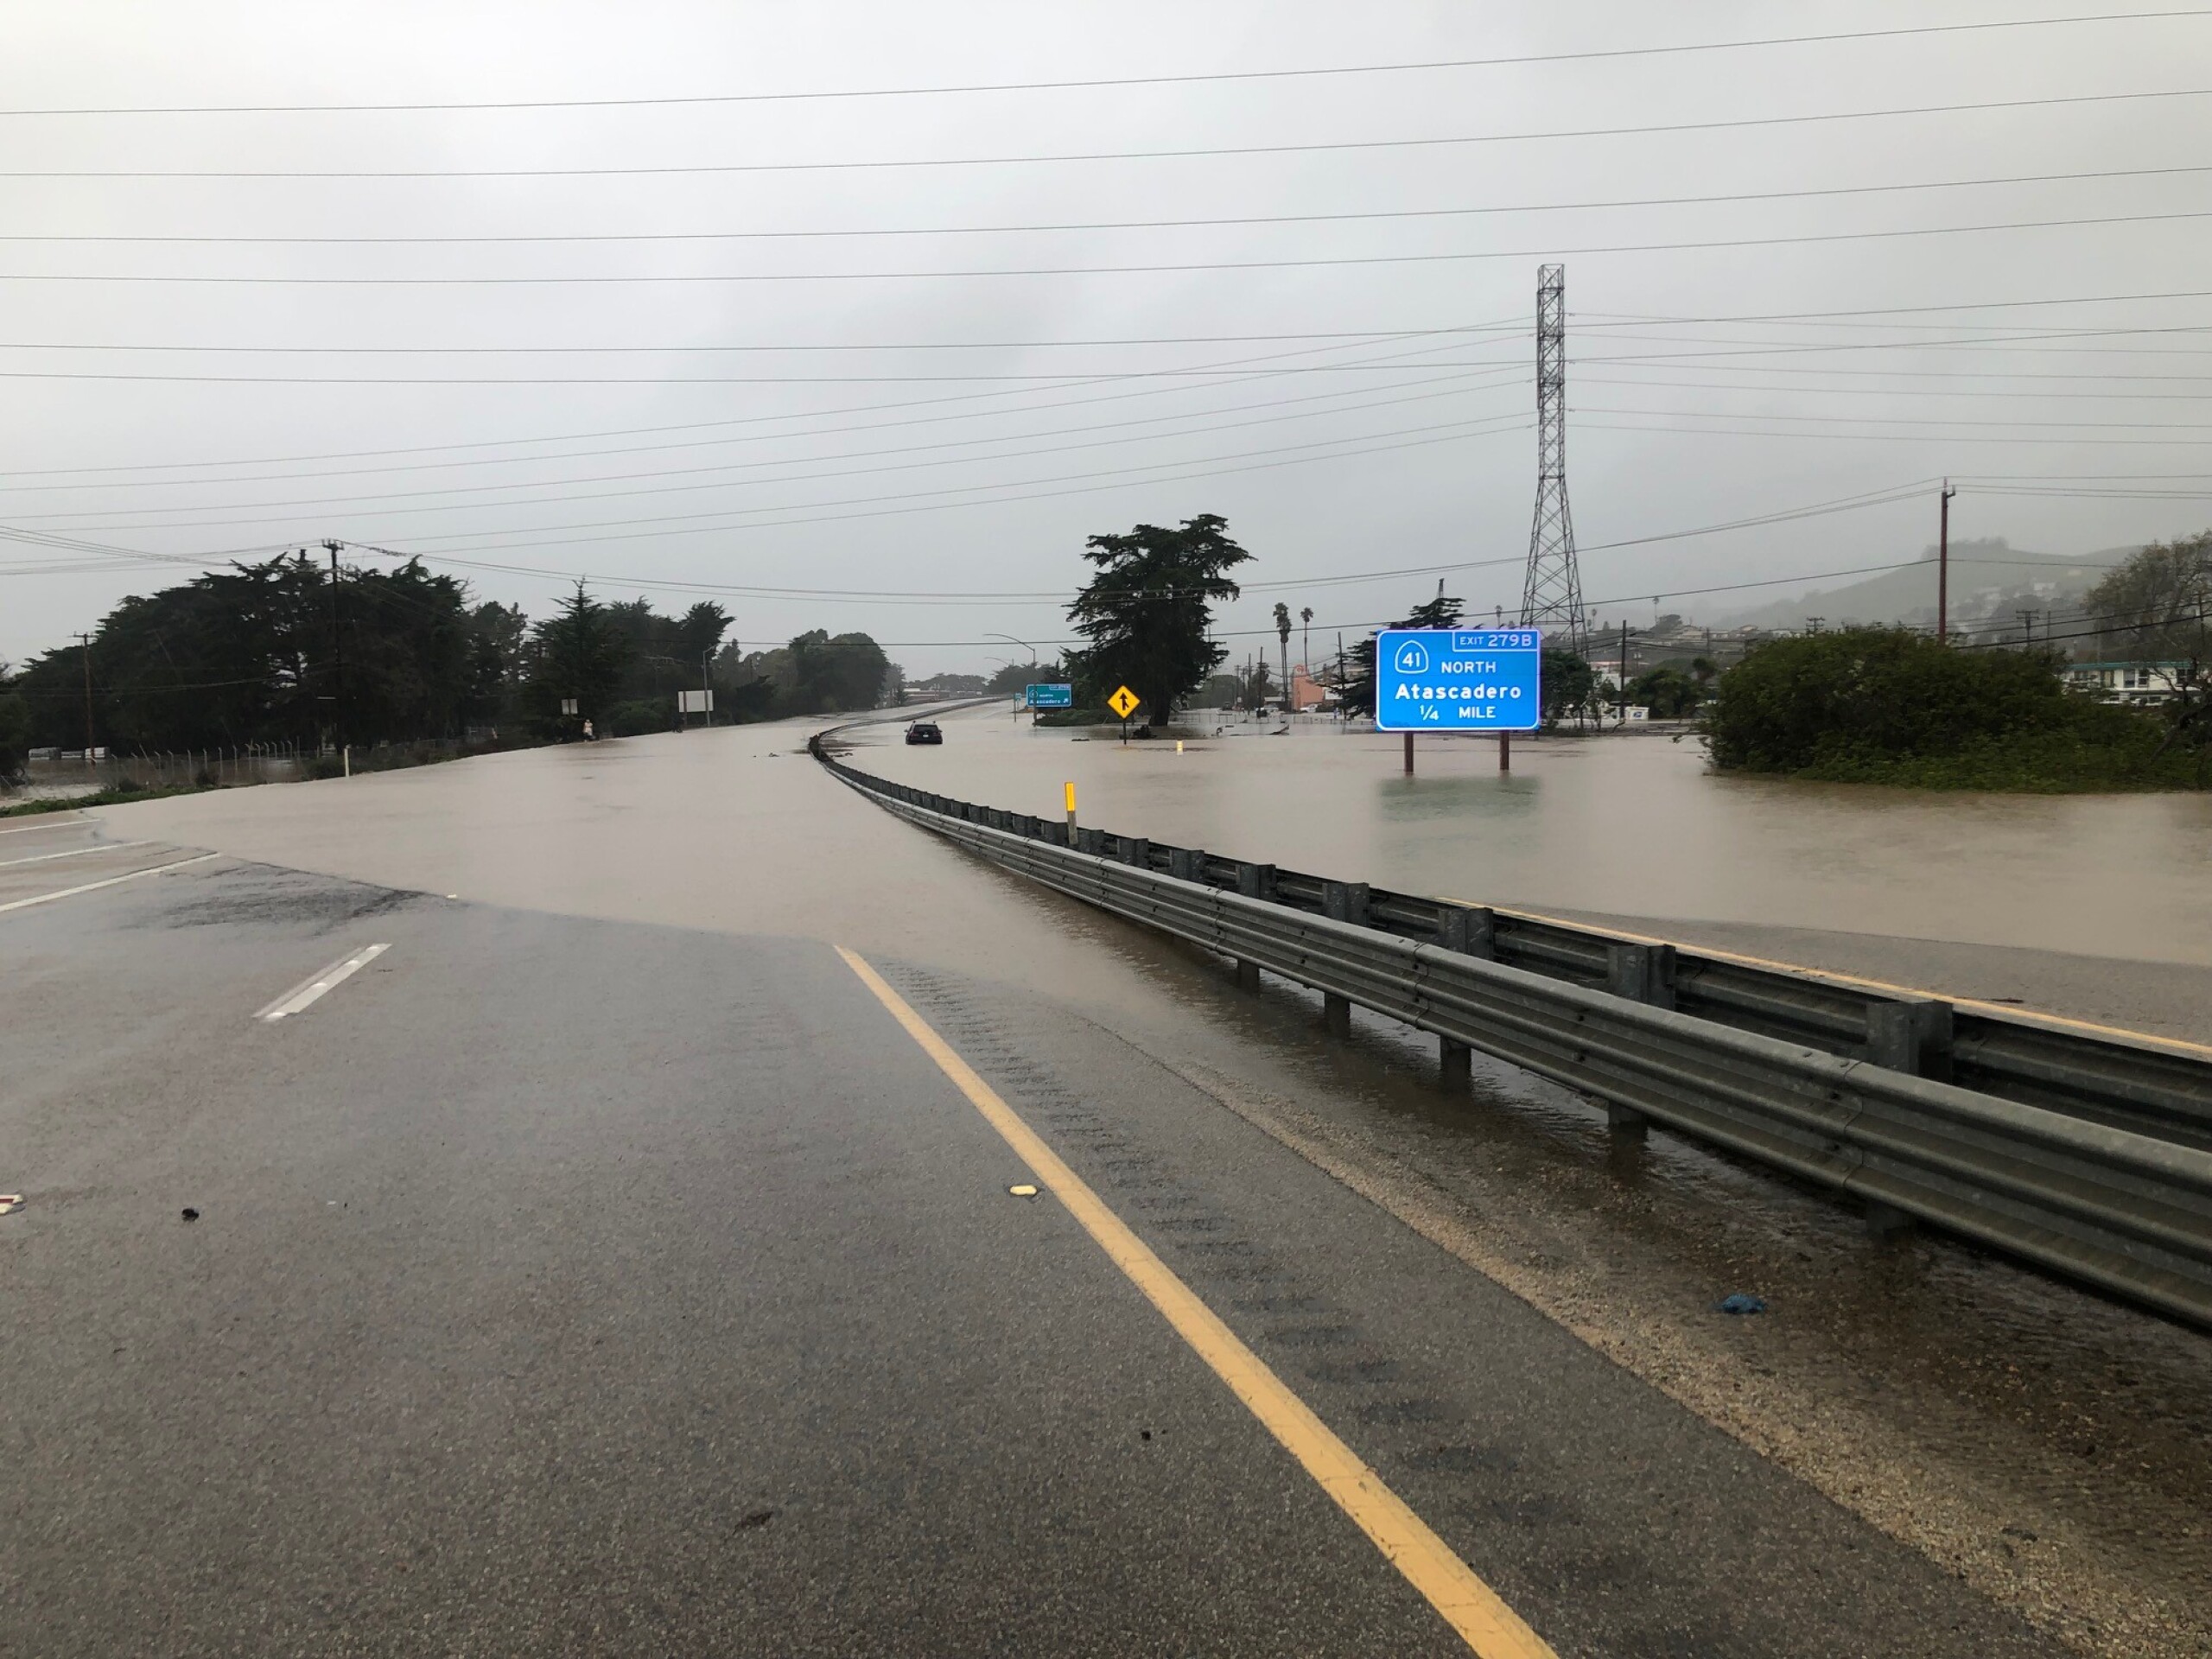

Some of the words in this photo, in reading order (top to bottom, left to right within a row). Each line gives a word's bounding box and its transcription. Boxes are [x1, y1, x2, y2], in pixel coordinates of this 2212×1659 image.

[1459, 636, 1484, 645] EXIT
[1487, 634, 1533, 647] 279B
[1402, 652, 1421, 668] 41
[1440, 661, 1497, 673] NORTH
[1395, 683, 1522, 700] Atascadero
[1459, 706, 1497, 719] MILE
